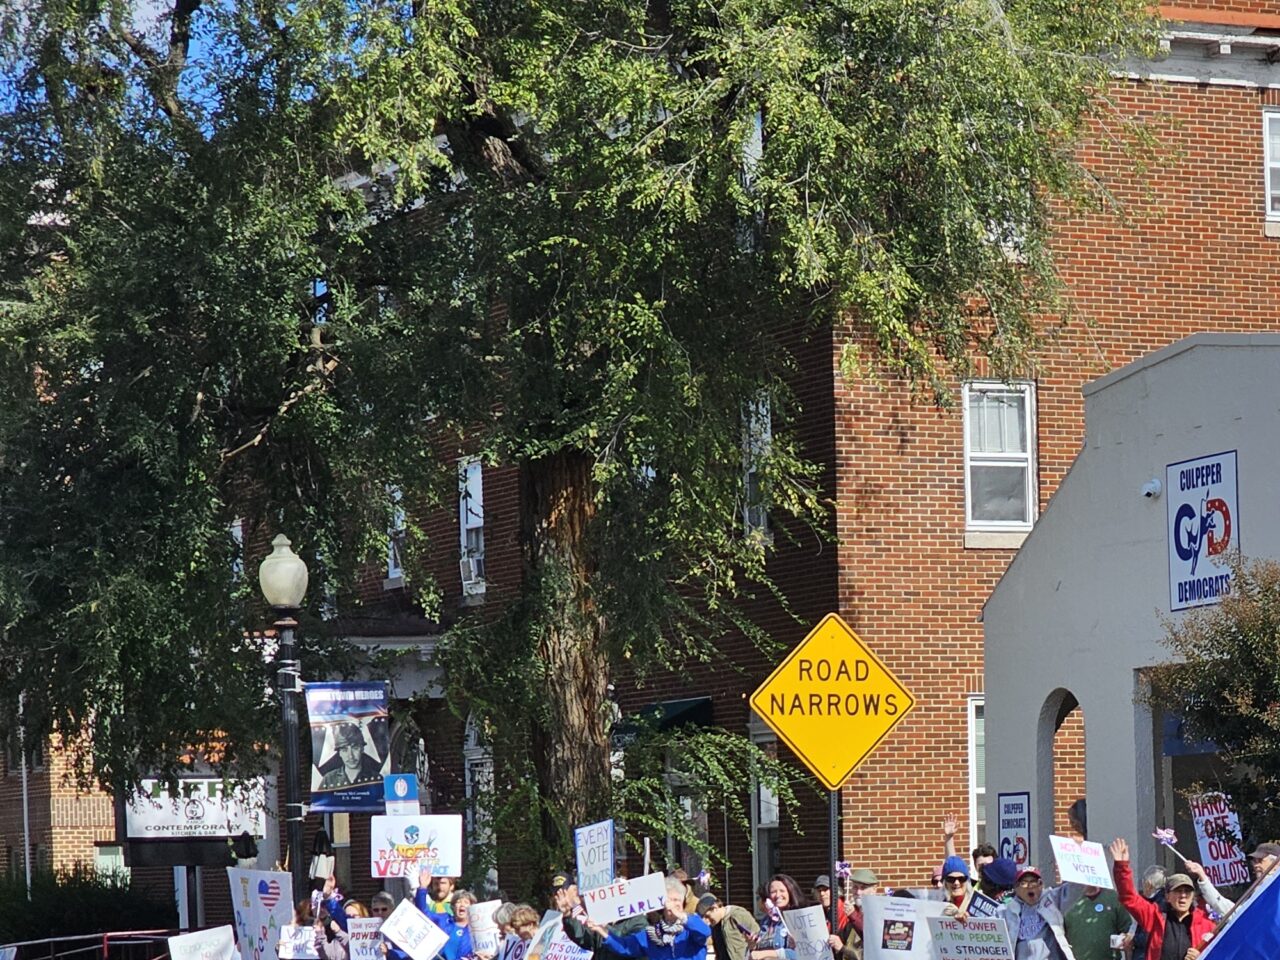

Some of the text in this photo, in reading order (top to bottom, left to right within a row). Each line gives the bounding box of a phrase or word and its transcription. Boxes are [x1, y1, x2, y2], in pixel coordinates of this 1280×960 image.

[1180, 463, 1222, 491] CULPEPER
[1178, 574, 1231, 602] DEMOCRATS
[799, 659, 870, 681] ROAD
[770, 693, 898, 716] NARROWS
[1190, 797, 1230, 818] HAND
[576, 824, 610, 848] EVERY
[1205, 815, 1230, 838] OFF
[581, 842, 609, 867] VOTE
[1208, 840, 1237, 861] OUR
[1073, 863, 1097, 874] VOTE
[1205, 860, 1249, 885] BALLOTS
[618, 896, 665, 917] EARLY
[935, 931, 1004, 943] of the PEOPLE
[938, 921, 997, 932] THE POWER
[956, 945, 1009, 956] STRONGER
